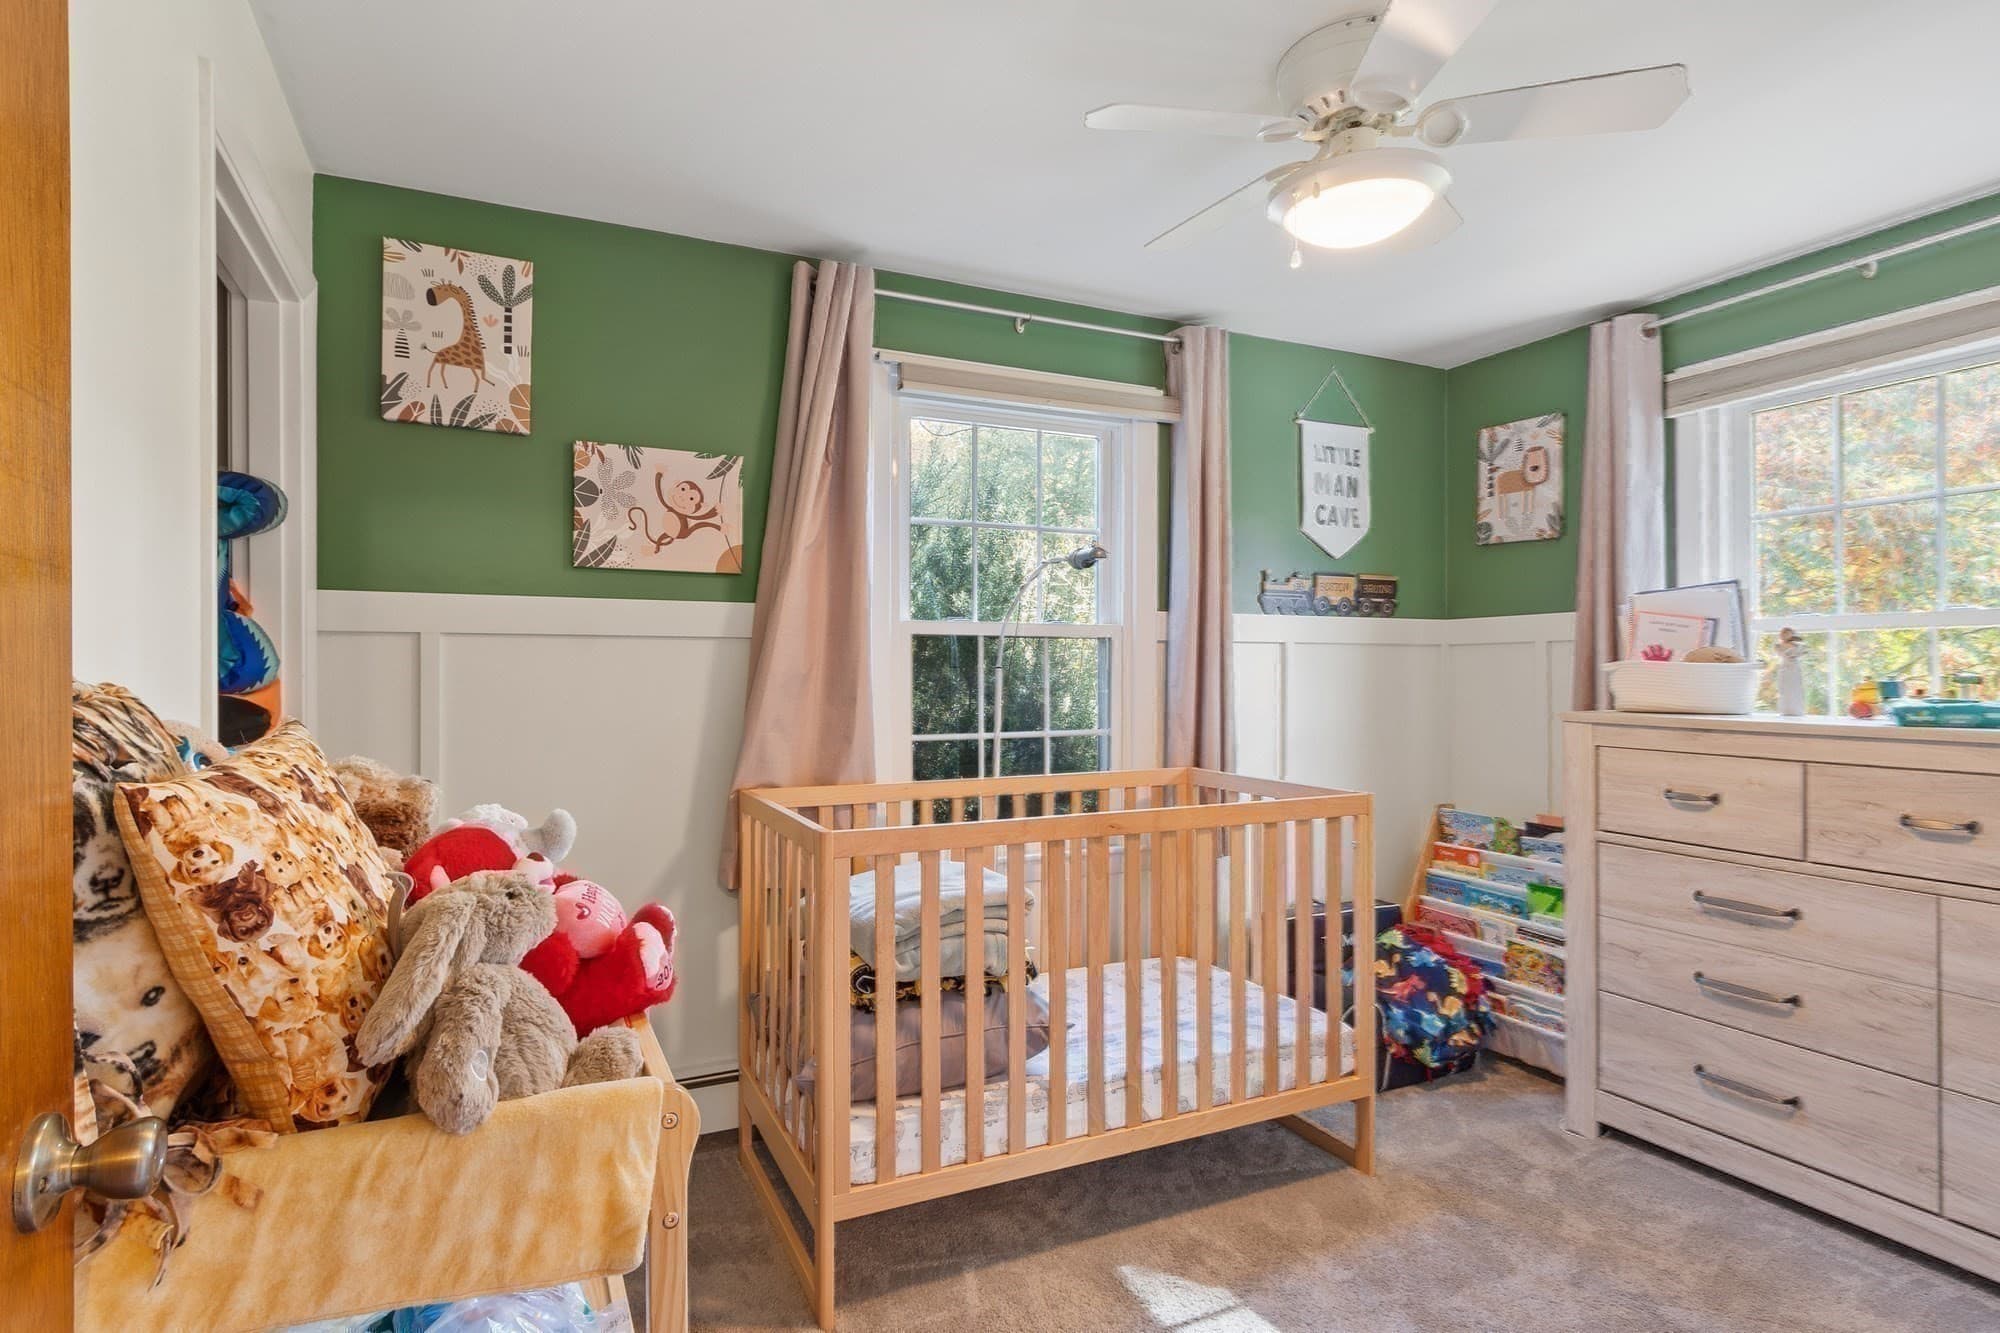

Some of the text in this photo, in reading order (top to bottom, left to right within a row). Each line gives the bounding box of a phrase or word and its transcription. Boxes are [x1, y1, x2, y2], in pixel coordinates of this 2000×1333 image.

[1313, 443, 1361, 468] LITTLE
[1313, 472, 1358, 498] MAN
[1315, 504, 1361, 528] CAVE
